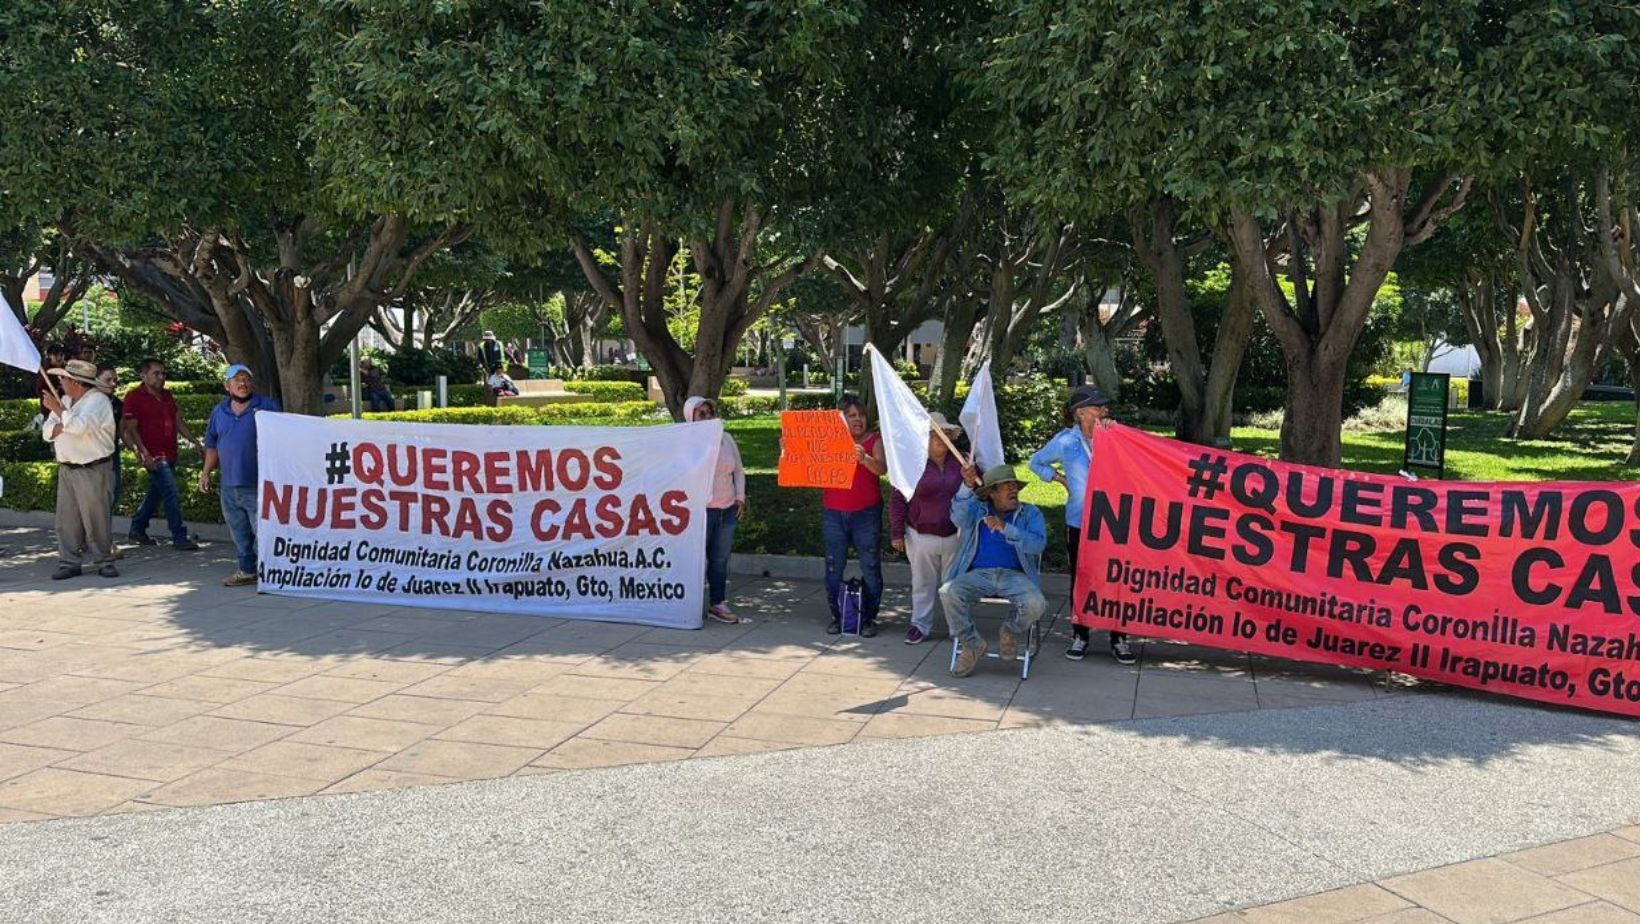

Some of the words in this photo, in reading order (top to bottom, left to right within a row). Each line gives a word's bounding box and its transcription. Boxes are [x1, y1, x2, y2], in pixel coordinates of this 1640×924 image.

[325, 441, 623, 494] #QUEREMOS
[261, 480, 513, 543] NUESTRAS
[530, 490, 691, 542] CASAS
[1087, 490, 1481, 596] NUESTRAS
[258, 560, 351, 590] Ampliación
[376, 571, 398, 593] de
[402, 574, 465, 595] Juarez
[486, 576, 571, 600] Irapuato,
[576, 575, 614, 602] Gto,
[619, 576, 685, 600] Mexico
[273, 536, 352, 564] Dignidad
[356, 540, 461, 571] Comunitaria
[466, 549, 543, 573] Coronilla
[1106, 558, 1217, 597] Dignidad
[1226, 576, 1393, 628] Comunitaria
[1402, 604, 1537, 649] Coronilla
[1082, 590, 1224, 635] Ampliación
[1265, 619, 1298, 646] de
[1306, 627, 1401, 663] Juarez
[1410, 642, 1430, 669] II
[1440, 648, 1577, 698] Irapuato,
